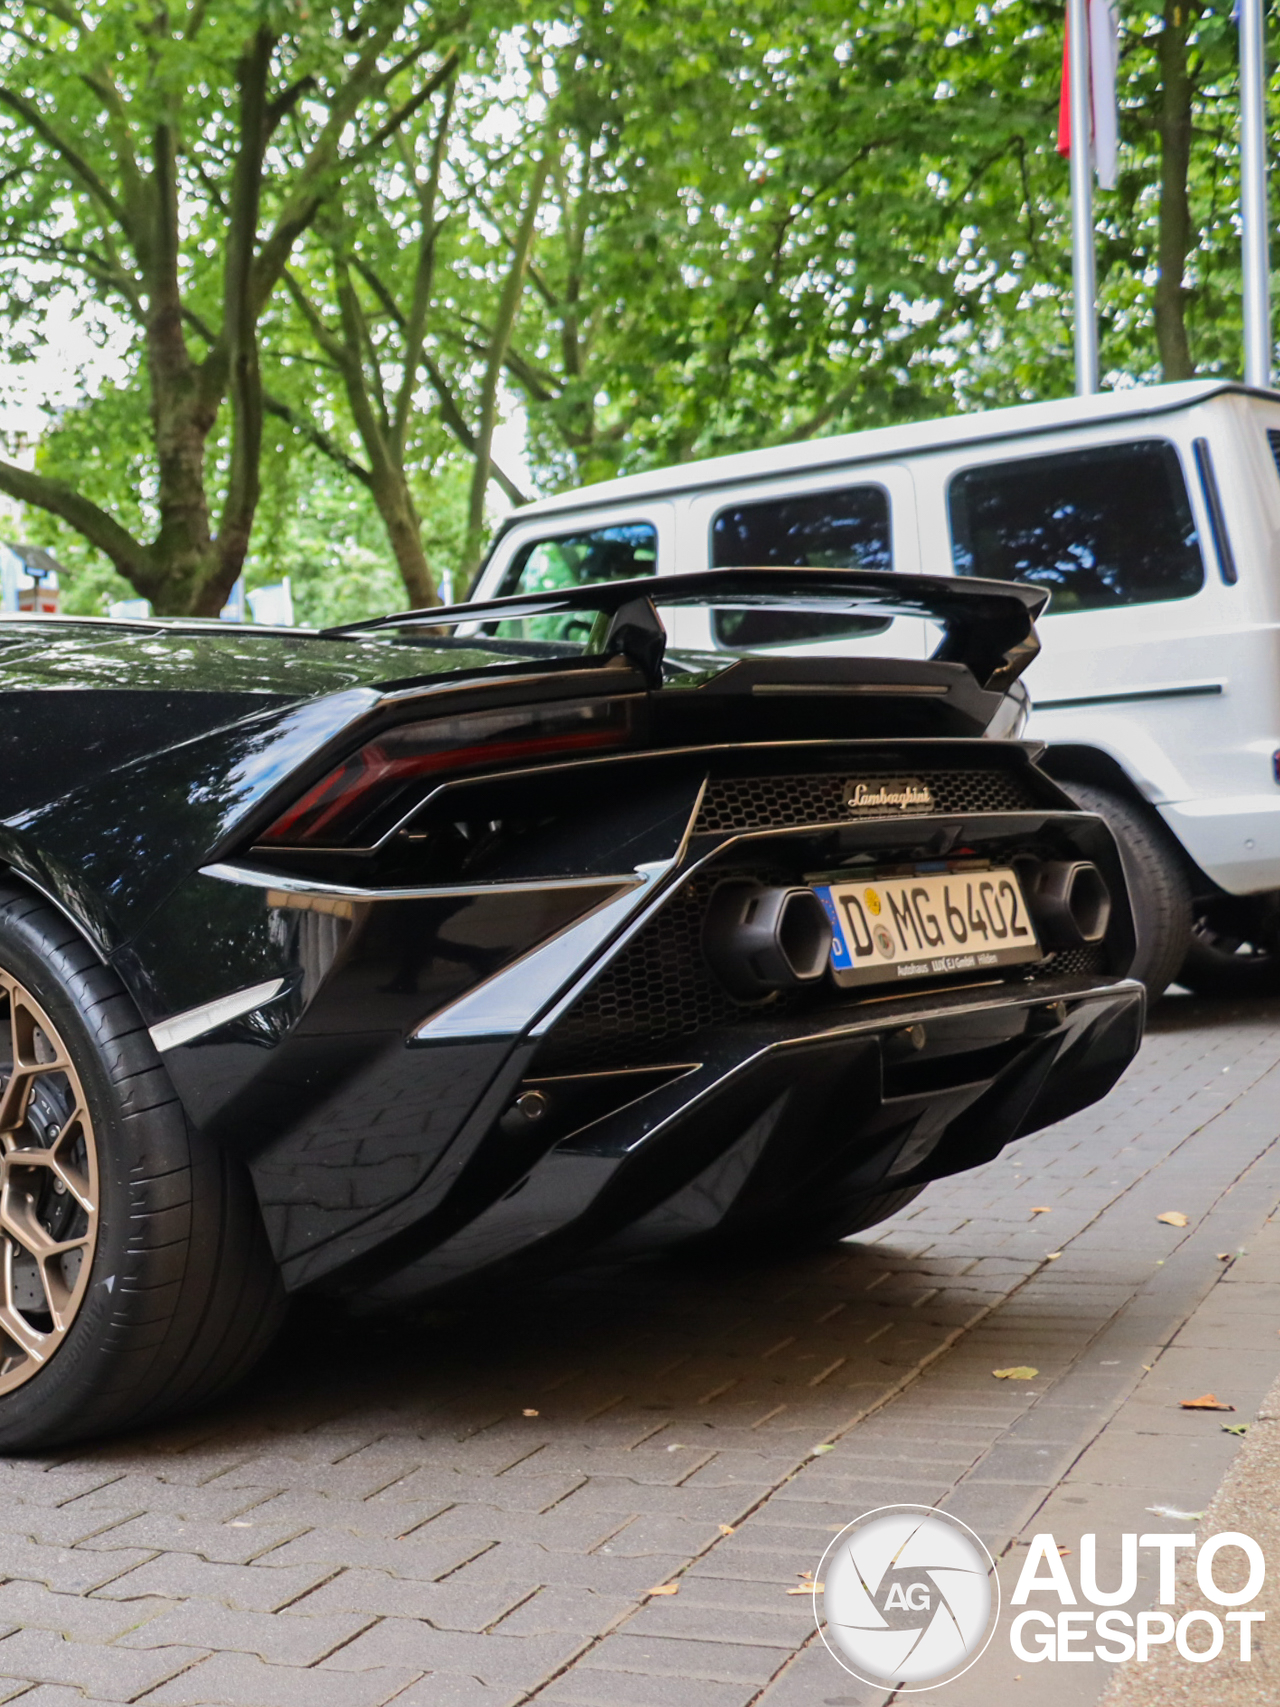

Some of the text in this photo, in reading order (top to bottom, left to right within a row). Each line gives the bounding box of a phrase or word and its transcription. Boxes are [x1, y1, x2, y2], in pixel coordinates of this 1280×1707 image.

[847, 784, 930, 809] Lamborghini
[838, 880, 1028, 958] D MG 6402
[832, 937, 843, 956] D
[897, 962, 929, 976] Autohaus
